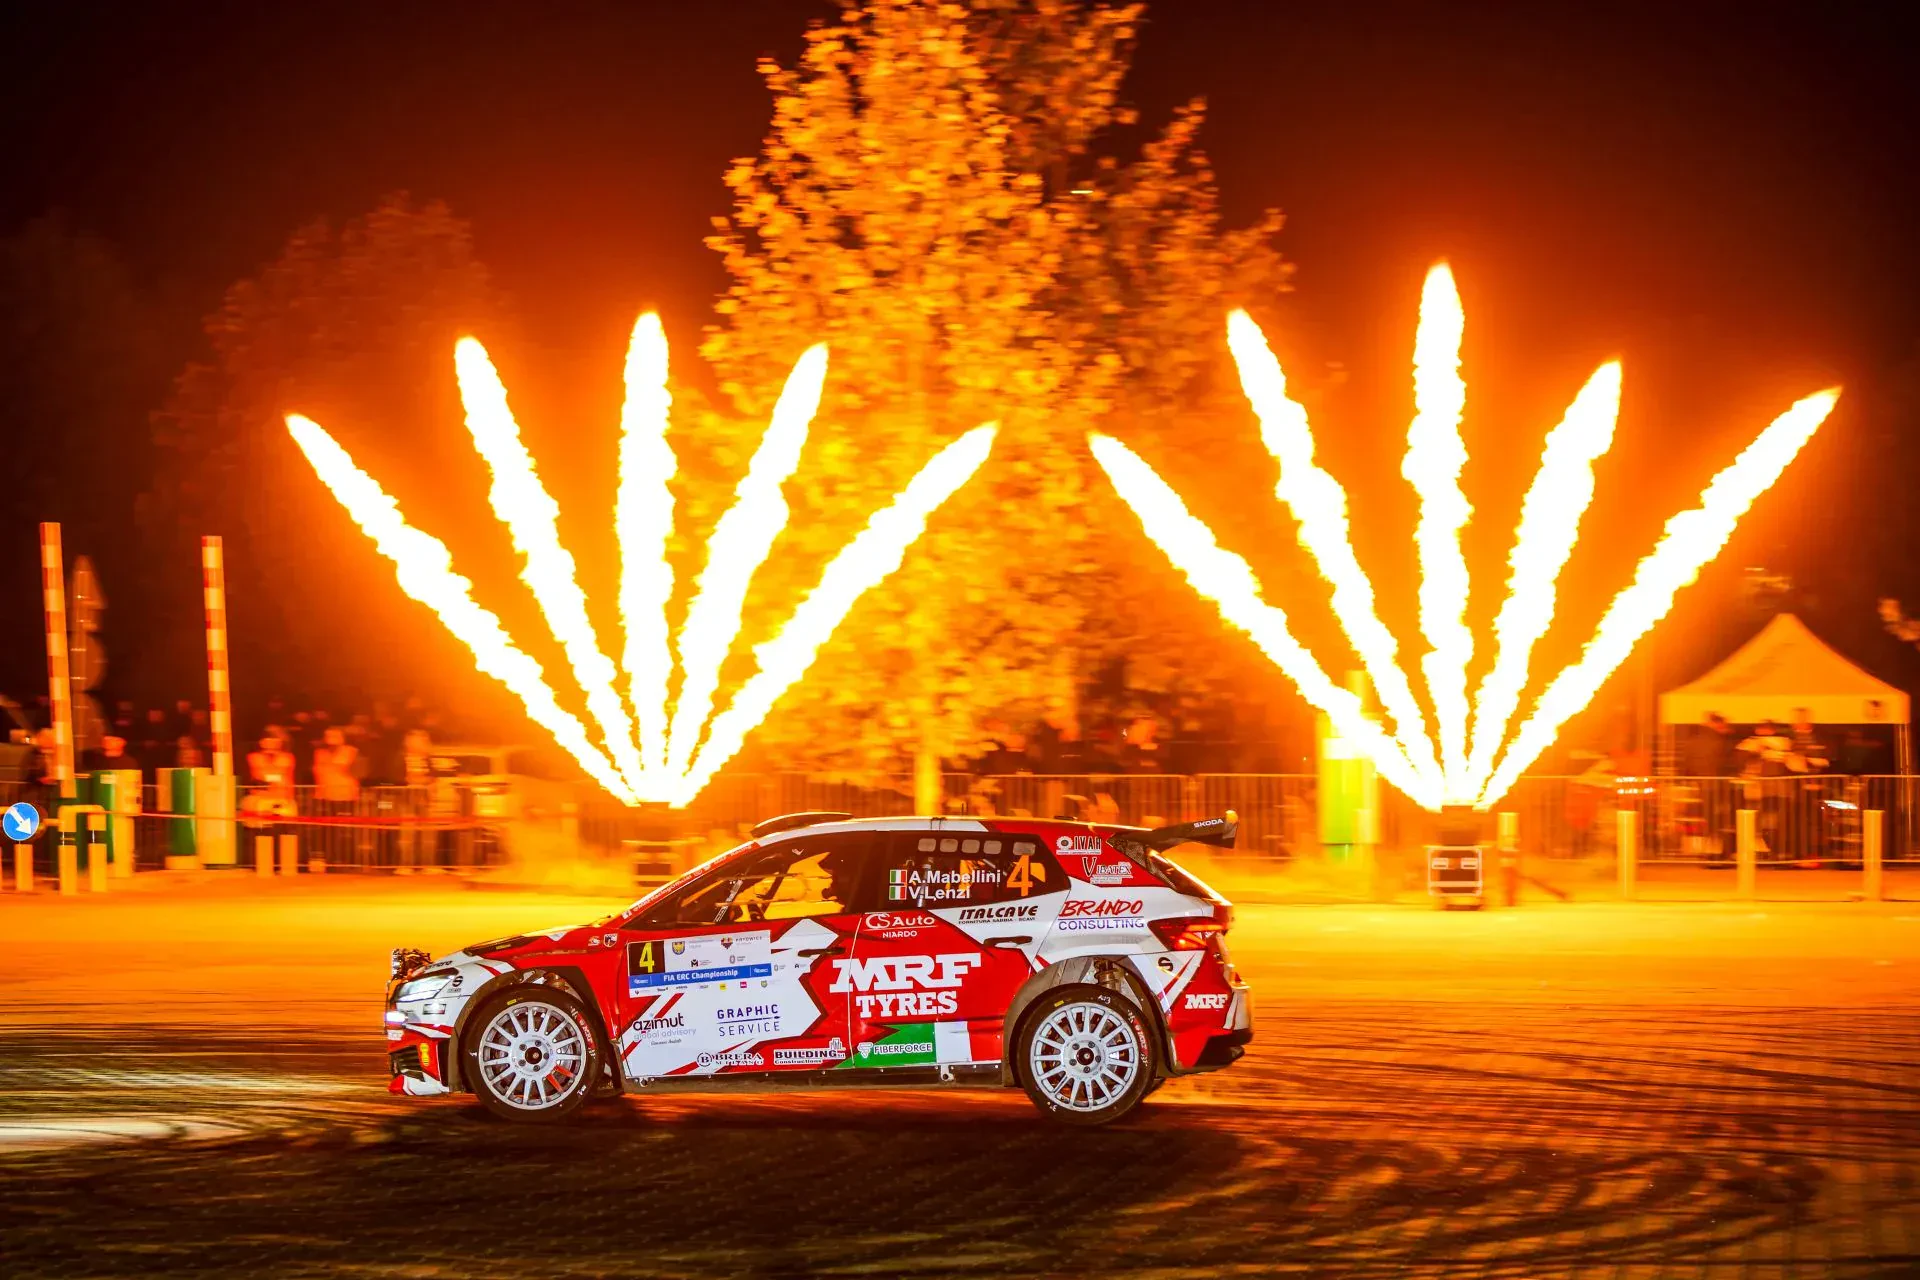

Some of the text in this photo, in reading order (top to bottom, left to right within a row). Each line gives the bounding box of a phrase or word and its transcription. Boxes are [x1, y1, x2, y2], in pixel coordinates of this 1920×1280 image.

[908, 869, 1000, 884] A.Mabellini
[1006, 855, 1034, 897] 4
[908, 886, 971, 900] V.Lenzi
[959, 905, 1038, 920] ITALCAVE
[1058, 899, 1143, 917] BRANDO
[1058, 919, 1144, 930] CONSULTING
[882, 931, 917, 939] NIARDO
[639, 942, 655, 973] 4
[663, 969, 738, 982] FIA ERC Championship
[829, 952, 982, 993] MRF
[856, 991, 958, 1018] TYRES
[1185, 994, 1228, 1009] MRF
[717, 1004, 779, 1019] GRAPHIC
[632, 1013, 684, 1031] azimut
[718, 1021, 780, 1036] SERVICE
[661, 1027, 697, 1038] advisory
[775, 1050, 836, 1059] BUILDING
[874, 1043, 932, 1054] FIBERFORCE
